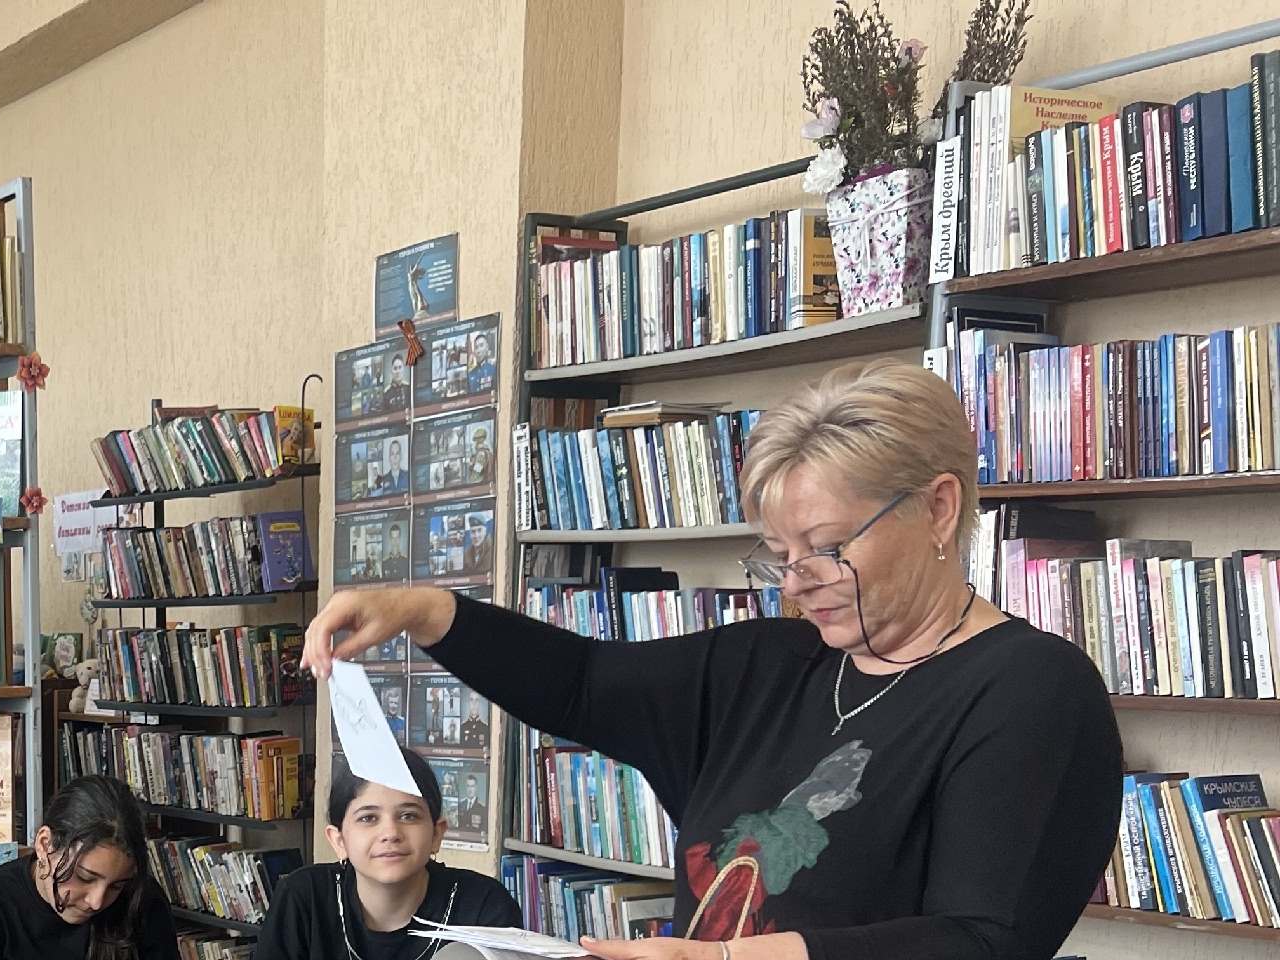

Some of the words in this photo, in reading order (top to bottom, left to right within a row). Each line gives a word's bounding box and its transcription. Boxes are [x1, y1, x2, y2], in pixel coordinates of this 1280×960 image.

[1023, 92, 1103, 109] Историческое
[1035, 106, 1087, 121] Наследие
[1102, 126, 1112, 160] Крым
[938, 147, 955, 218] древний
[1127, 151, 1144, 197] Крым
[935, 222, 951, 274] Крым
[1203, 780, 1258, 795] КРЫМСКИЕ
[1222, 796, 1262, 808] ЧУДЕСА
[1130, 817, 1139, 844] ОСТРОВ
[1131, 845, 1148, 900] ТАИНСТВЕННЫЙ
[1202, 843, 1222, 894] КРЫМСКИЕ
